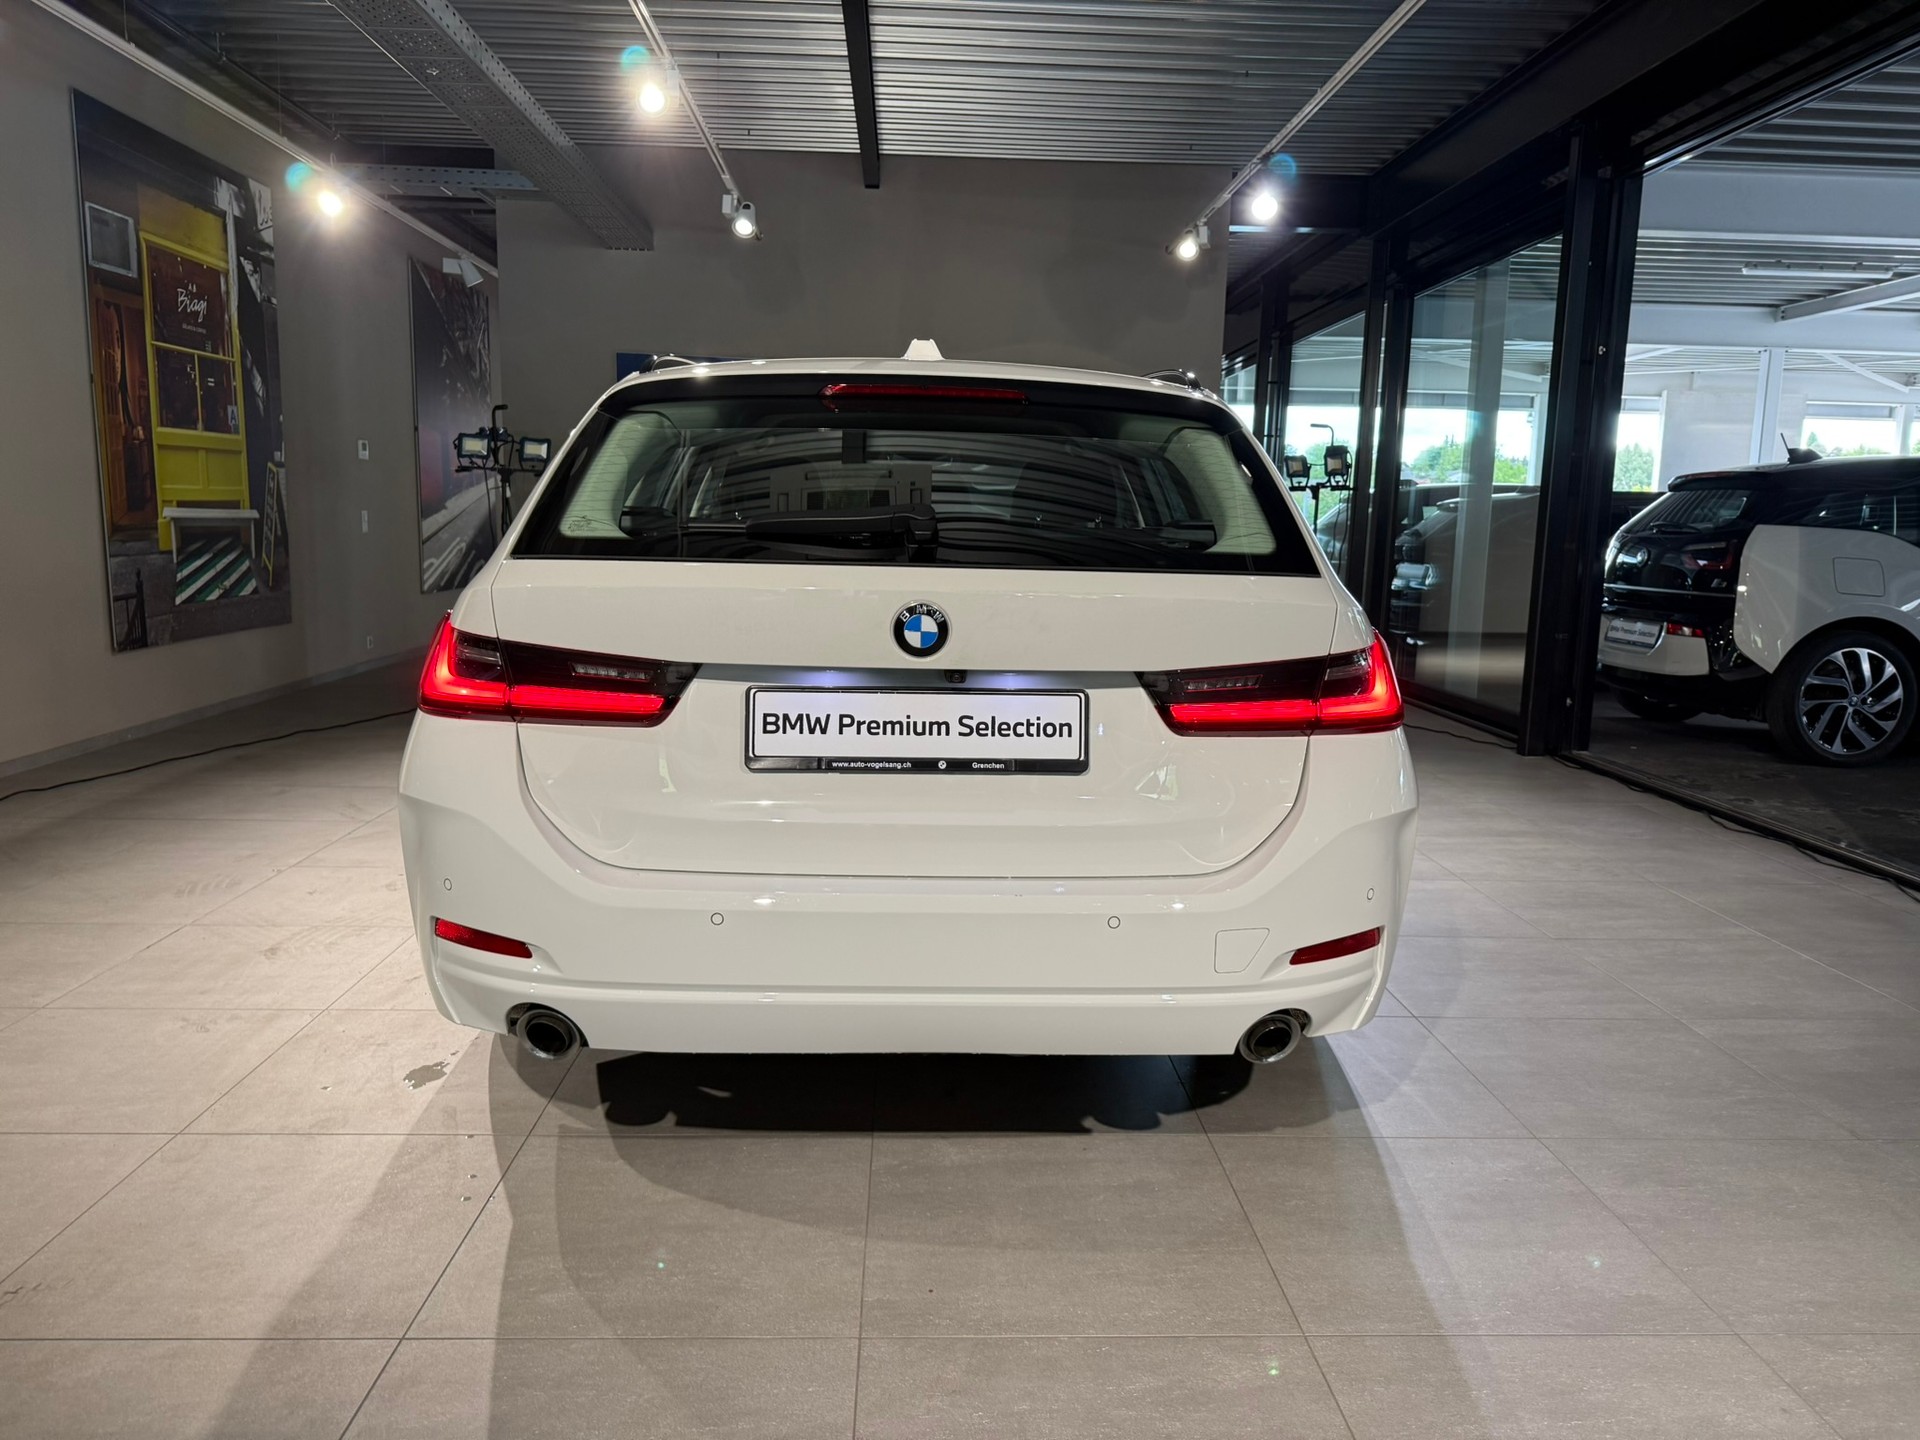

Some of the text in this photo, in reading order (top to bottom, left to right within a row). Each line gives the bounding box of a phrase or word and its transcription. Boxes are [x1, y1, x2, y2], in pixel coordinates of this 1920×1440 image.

[177, 288, 207, 322] Biagi
[900, 604, 945, 623] BMW
[762, 712, 1073, 739] BMW Premium Selection
[832, 761, 1005, 770] www.auto-vogelsang.ch Grenchen
